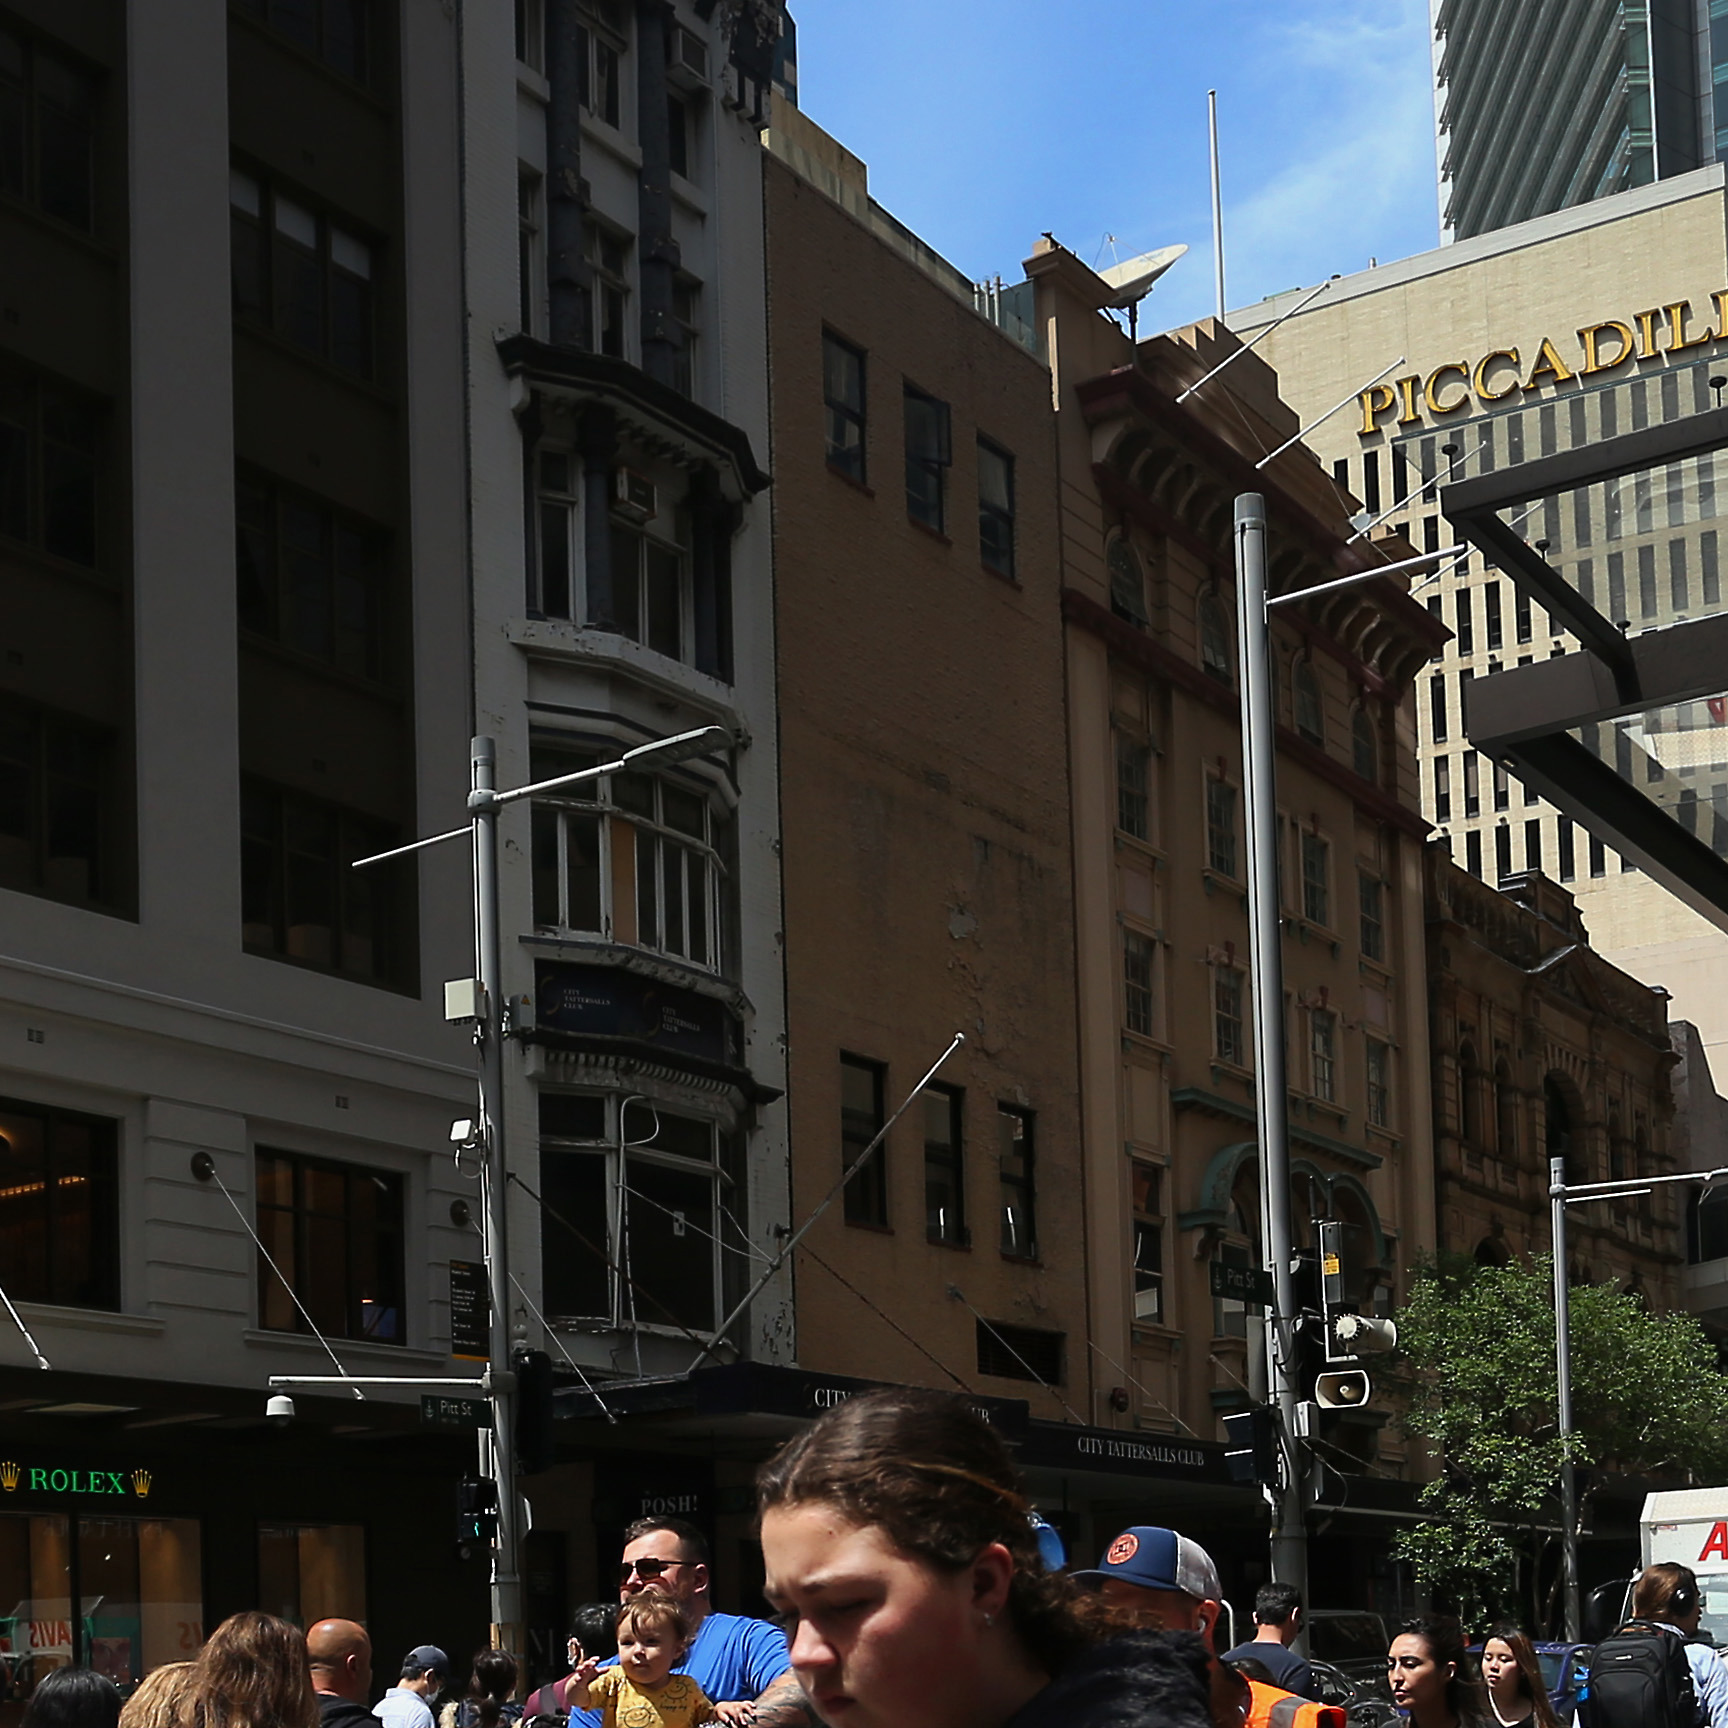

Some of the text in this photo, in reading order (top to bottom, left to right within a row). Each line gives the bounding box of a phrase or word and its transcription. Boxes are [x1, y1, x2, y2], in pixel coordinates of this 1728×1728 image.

[1227, 1267, 1256, 1289] Pitt St
[440, 1400, 472, 1416] Pitt St
[1077, 1436, 1205, 1468] CITY TATTERSALLS CLUB
[28, 1467, 127, 1495] ROLEX
[640, 1494, 698, 1516] POSH!
